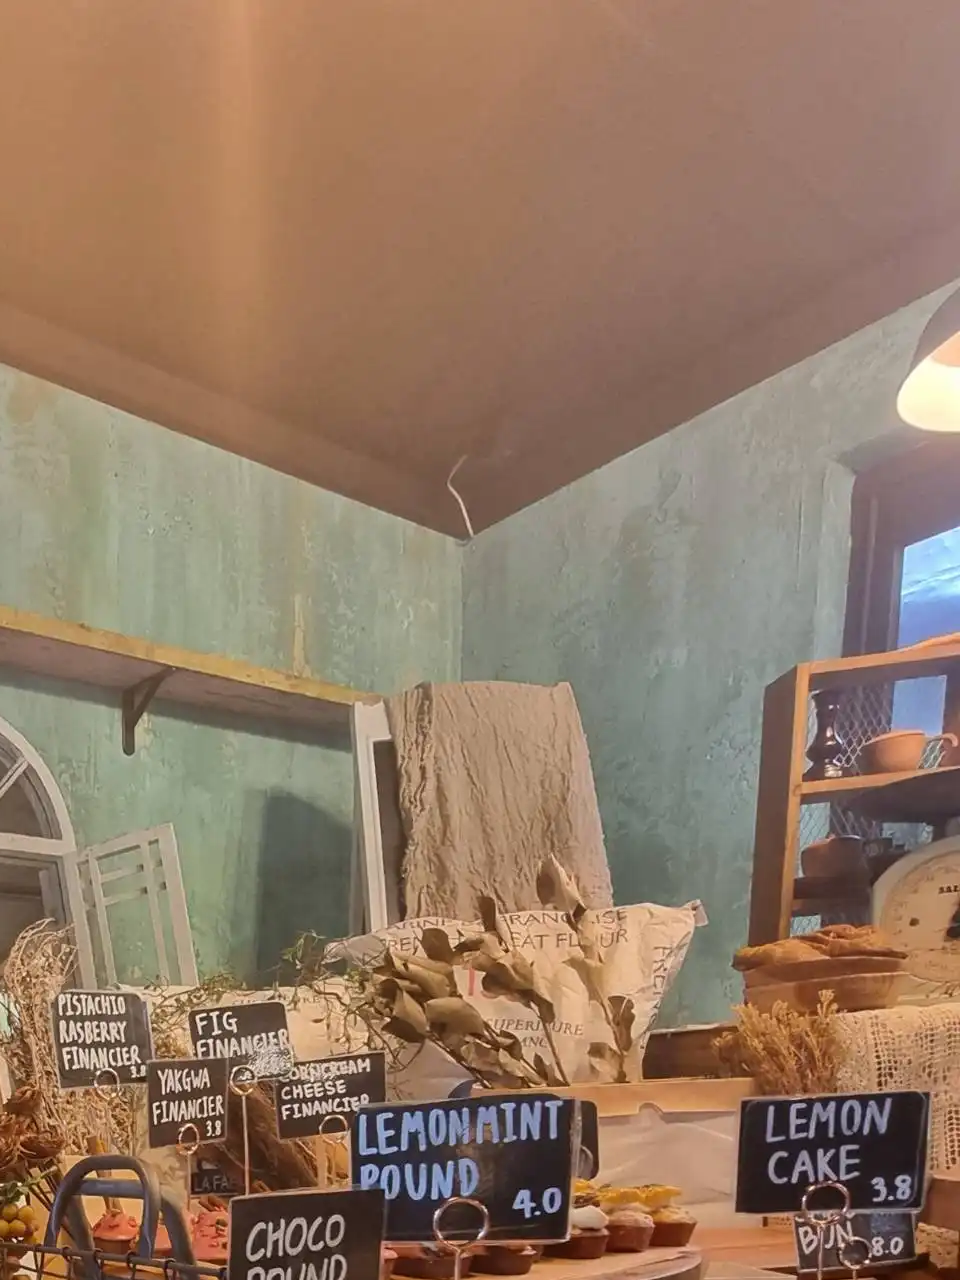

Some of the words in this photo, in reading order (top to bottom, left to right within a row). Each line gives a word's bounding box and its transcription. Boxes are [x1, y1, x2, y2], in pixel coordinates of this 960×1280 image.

[555, 928, 629, 949] FLUR
[58, 994, 126, 1016] PISTACHIO
[59, 1020, 127, 1044] RASBERRY
[195, 1011, 238, 1036] FIG
[196, 1028, 290, 1059] FINANCIER
[62, 1045, 142, 1071] FINANCIER
[158, 1068, 211, 1096] YAKGWA
[281, 1079, 347, 1100] CHEESE
[152, 1095, 224, 1125] FINANCIER
[281, 1094, 370, 1120] FINANCIER
[765, 1098, 892, 1143] LEMON
[206, 1120, 222, 1137] 3.8
[767, 1144, 861, 1184] CAKE
[361, 1157, 480, 1201] POUND
[870, 1174, 912, 1202] 3.8
[512, 1187, 563, 1218] 4.0
[245, 1213, 346, 1263] CHOCO
[871, 1236, 904, 1257] 8.0
